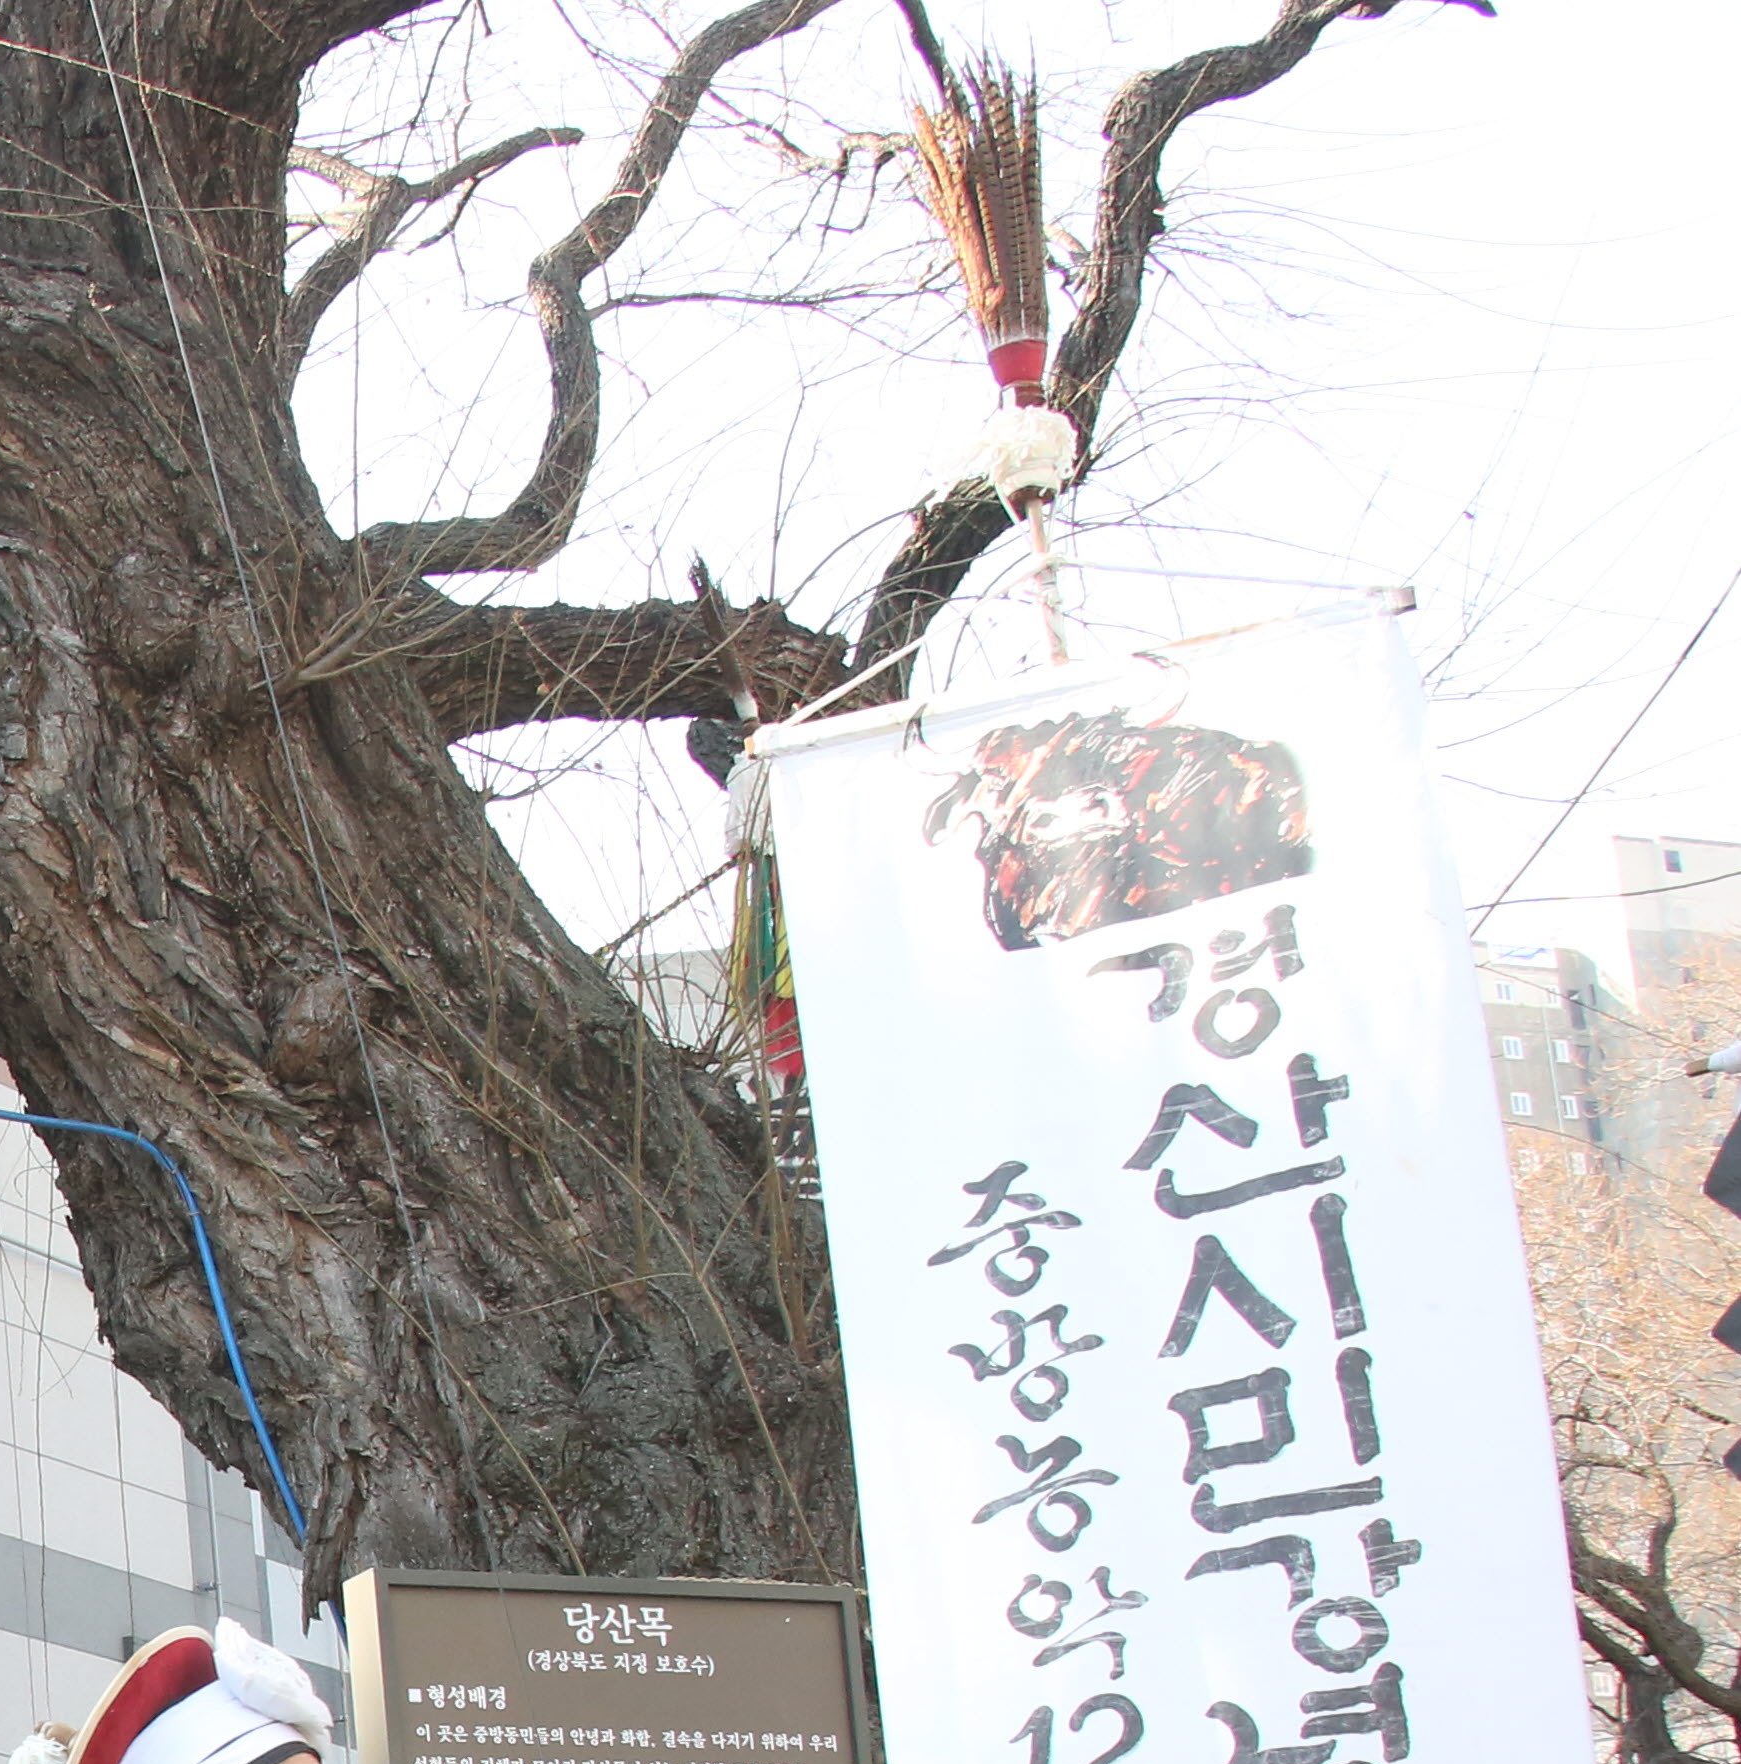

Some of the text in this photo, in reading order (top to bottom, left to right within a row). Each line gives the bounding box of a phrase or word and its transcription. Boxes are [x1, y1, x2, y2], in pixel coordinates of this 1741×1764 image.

[562, 1603, 673, 1647] 당산목
[527, 1648, 715, 1677] (경상북도 지정 보호수)
[425, 1684, 507, 1710] 형성배경
[415, 1723, 431, 1743] 이
[436, 1724, 469, 1743] 곳은
[472, 1725, 565, 1746] 중방동민들의
[569, 1727, 617, 1747] 안녕과
[661, 1729, 707, 1749] 결속을
[710, 1731, 755, 1751] 다지기
[761, 1732, 804, 1752] 위하여
[808, 1734, 838, 1753] 우리
